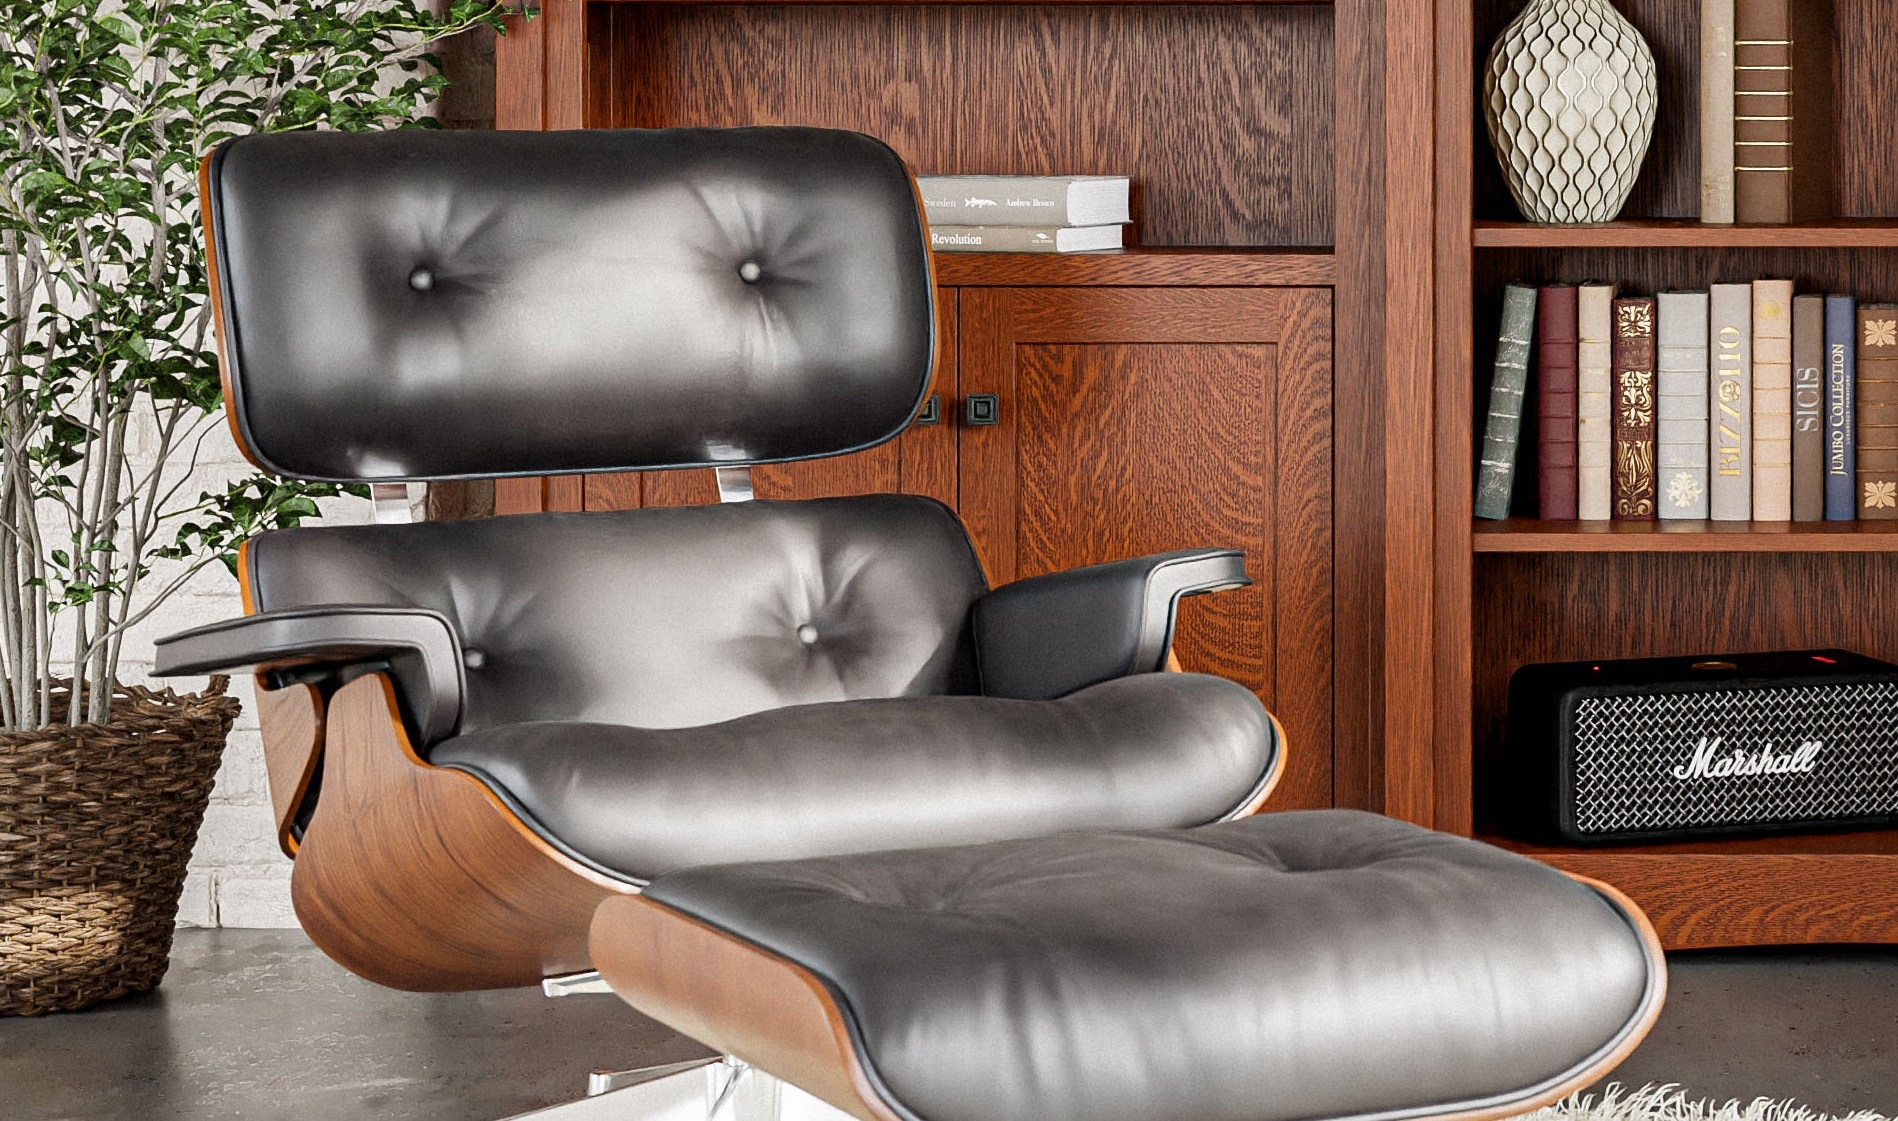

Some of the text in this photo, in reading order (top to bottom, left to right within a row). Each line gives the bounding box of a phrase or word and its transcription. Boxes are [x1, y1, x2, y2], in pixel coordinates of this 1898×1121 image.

[924, 197, 957, 208] Sweden
[1005, 197, 1055, 207] Andrew Brown
[931, 233, 982, 245] Revolution
[1795, 367, 1821, 433] SICIS
[1829, 344, 1849, 477] JUMBO COLLECTION
[1673, 736, 1824, 780] Marshall
